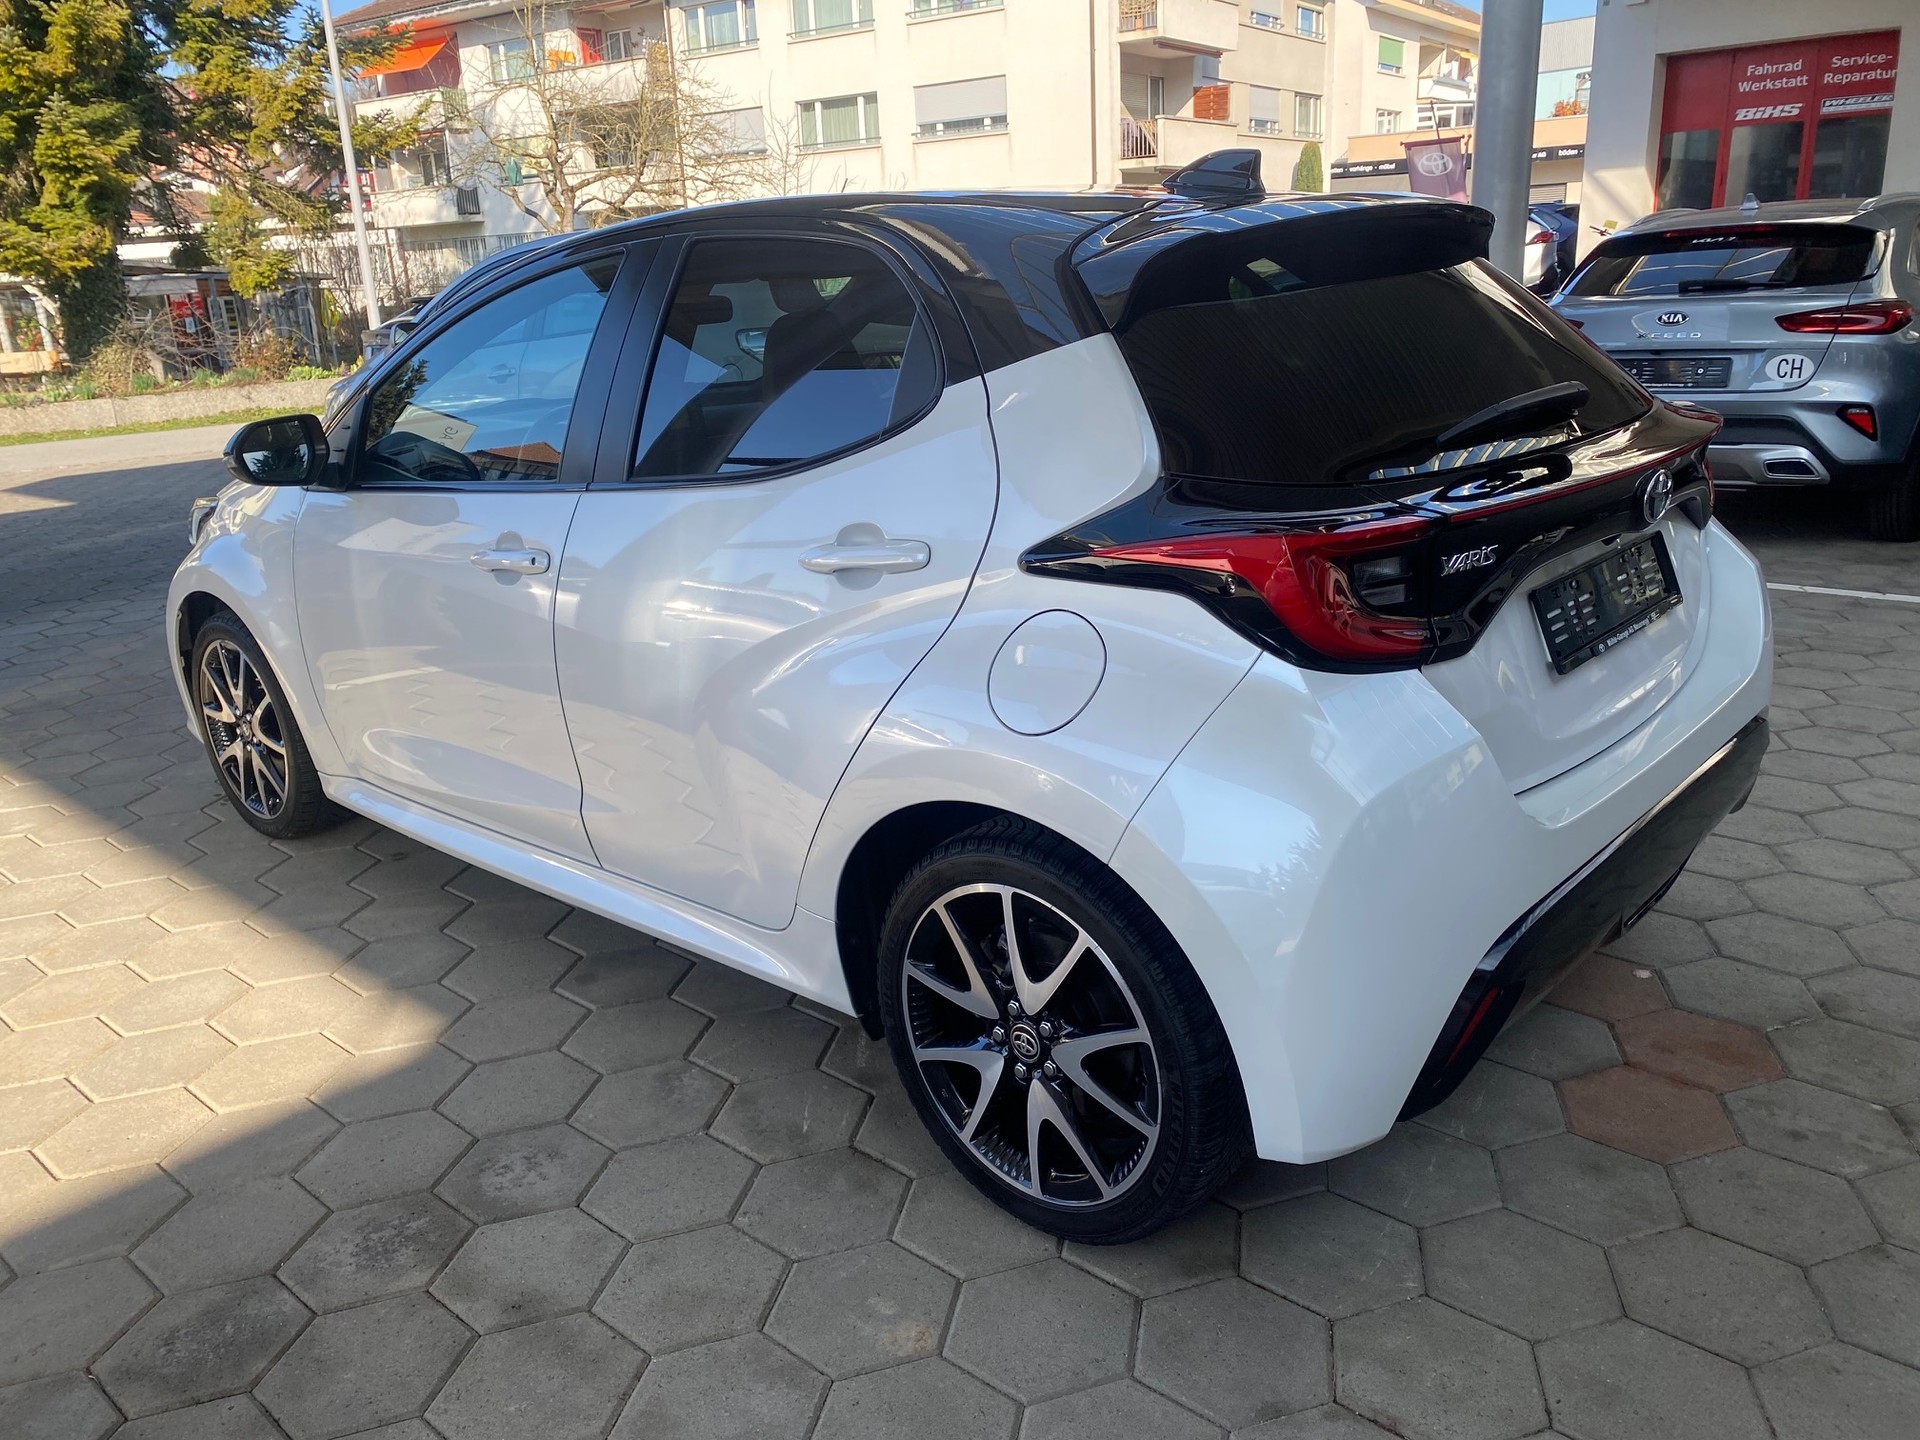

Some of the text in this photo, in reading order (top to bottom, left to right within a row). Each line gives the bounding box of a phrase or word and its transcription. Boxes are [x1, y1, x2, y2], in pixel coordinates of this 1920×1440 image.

[1747, 59, 1802, 76] Fahrrad
[1831, 53, 1893, 68] Service-
[1738, 75, 1809, 93] Werkstatt
[1824, 68, 1898, 85] Reparatur
[1824, 94, 1894, 107] WHEELER
[1659, 312, 1685, 324] KIA
[1776, 358, 1804, 379] CH
